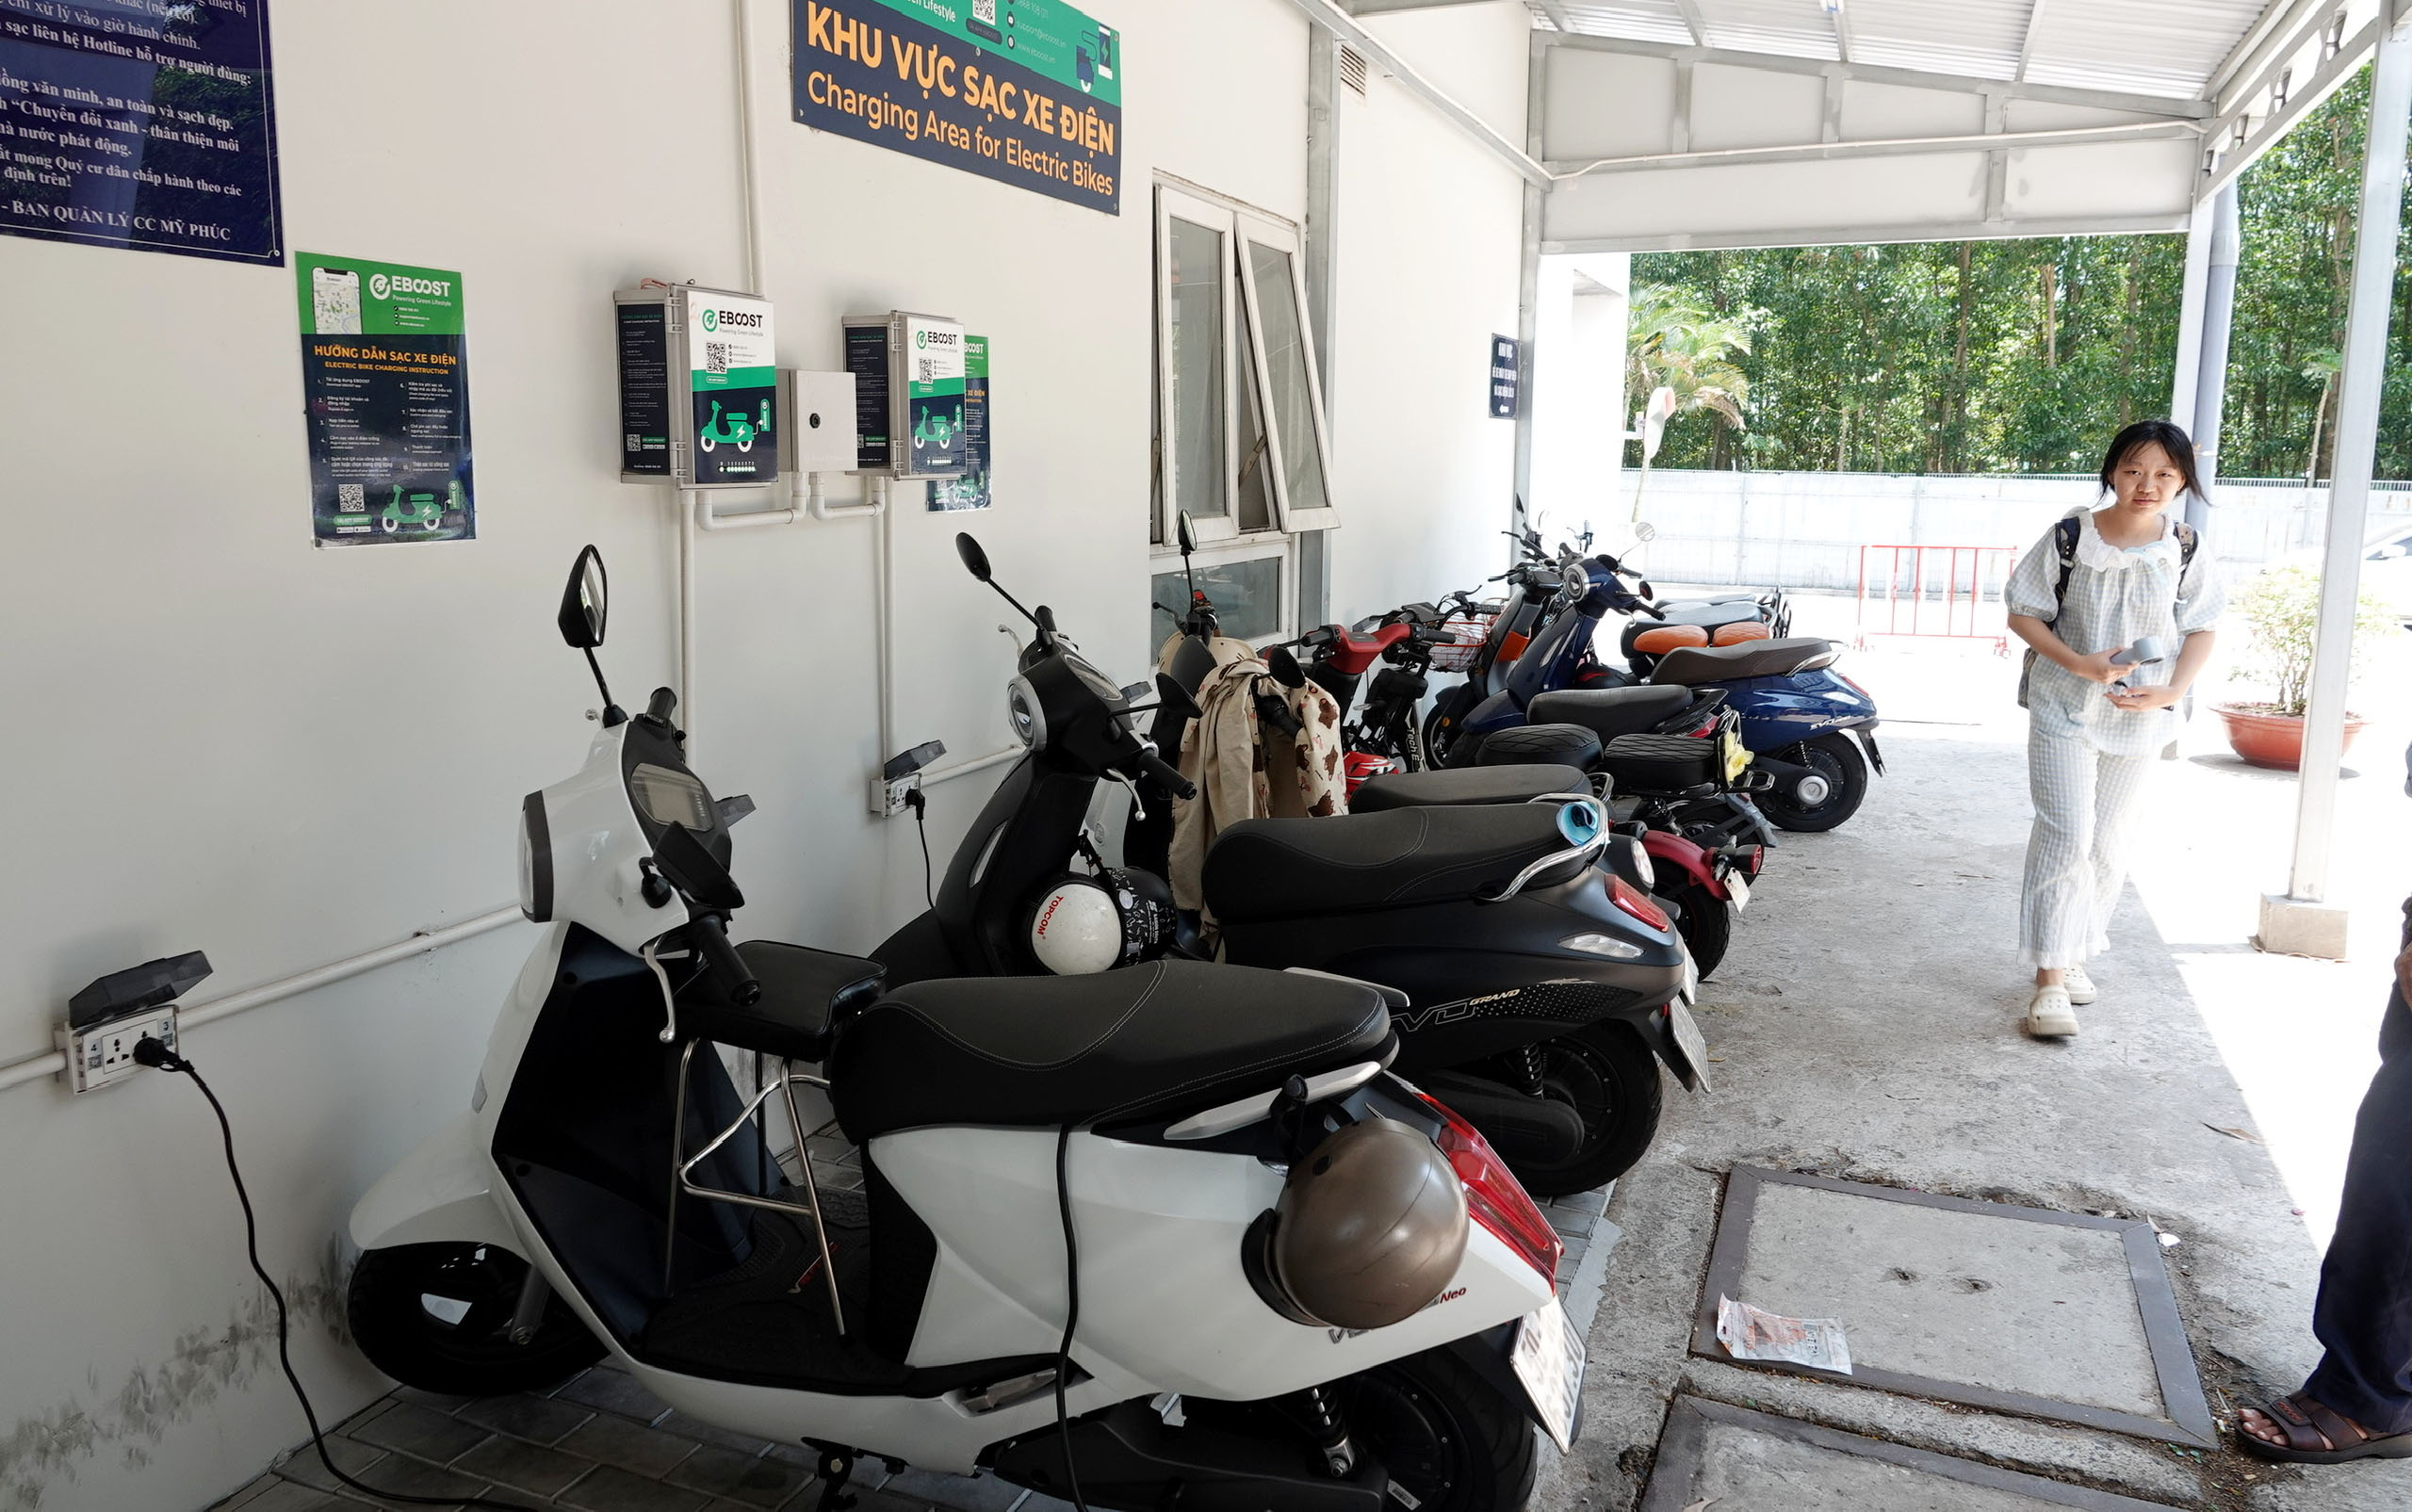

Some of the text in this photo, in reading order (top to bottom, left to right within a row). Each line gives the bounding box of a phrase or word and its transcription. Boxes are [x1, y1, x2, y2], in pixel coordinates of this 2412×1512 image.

[128, 21, 159, 40] hành
[6, 21, 252, 86] sạc liên hệ Hotline hỗ trợ người dùng:
[807, 0, 1115, 158] KHU VỰC SẠC XE ĐIỆN
[31, 80, 59, 97] văn
[63, 87, 104, 106] minh,
[106, 96, 124, 109] an
[126, 99, 156, 115] toàn
[159, 105, 175, 119] và
[177, 109, 205, 124] sạch
[19, 127, 56, 142] nước
[58, 132, 91, 148] phát
[106, 118, 139, 134] xanh
[150, 124, 180, 142] thân
[182, 130, 214, 149] thiện
[217, 138, 240, 153] môi
[807, 71, 1114, 196] Charging Area for Electric Bikes
[4, 167, 73, 187] định trên!
[14, 152, 53, 170] mong
[55, 155, 84, 174] Quý
[87, 163, 104, 175] cư
[106, 164, 130, 179] dân
[132, 167, 161, 187] chấp
[164, 172, 194, 189] hành
[196, 179, 221, 193] theo
[223, 184, 242, 197] các
[12, 199, 50, 218] BAN
[107, 210, 130, 227] LÝ
[133, 216, 157, 232] CC
[160, 218, 186, 235] MỸ
[189, 222, 231, 241] PHÚC
[392, 275, 451, 298] EBOOST
[719, 310, 763, 328] EBOOST
[927, 331, 957, 346] EBOOST
[314, 344, 457, 367] HƯỚNG DẪN SẠC XE ĐIỆN
[325, 361, 357, 369] ELECTRIC
[375, 365, 408, 373] CHARGING
[409, 366, 449, 375] INSTRUCTION
[1036, 895, 1065, 936] TOPCOM
[1469, 988, 1521, 1006] GRAND
[163, 1021, 170, 1032] 3
[1439, 1287, 1467, 1304] Neo
